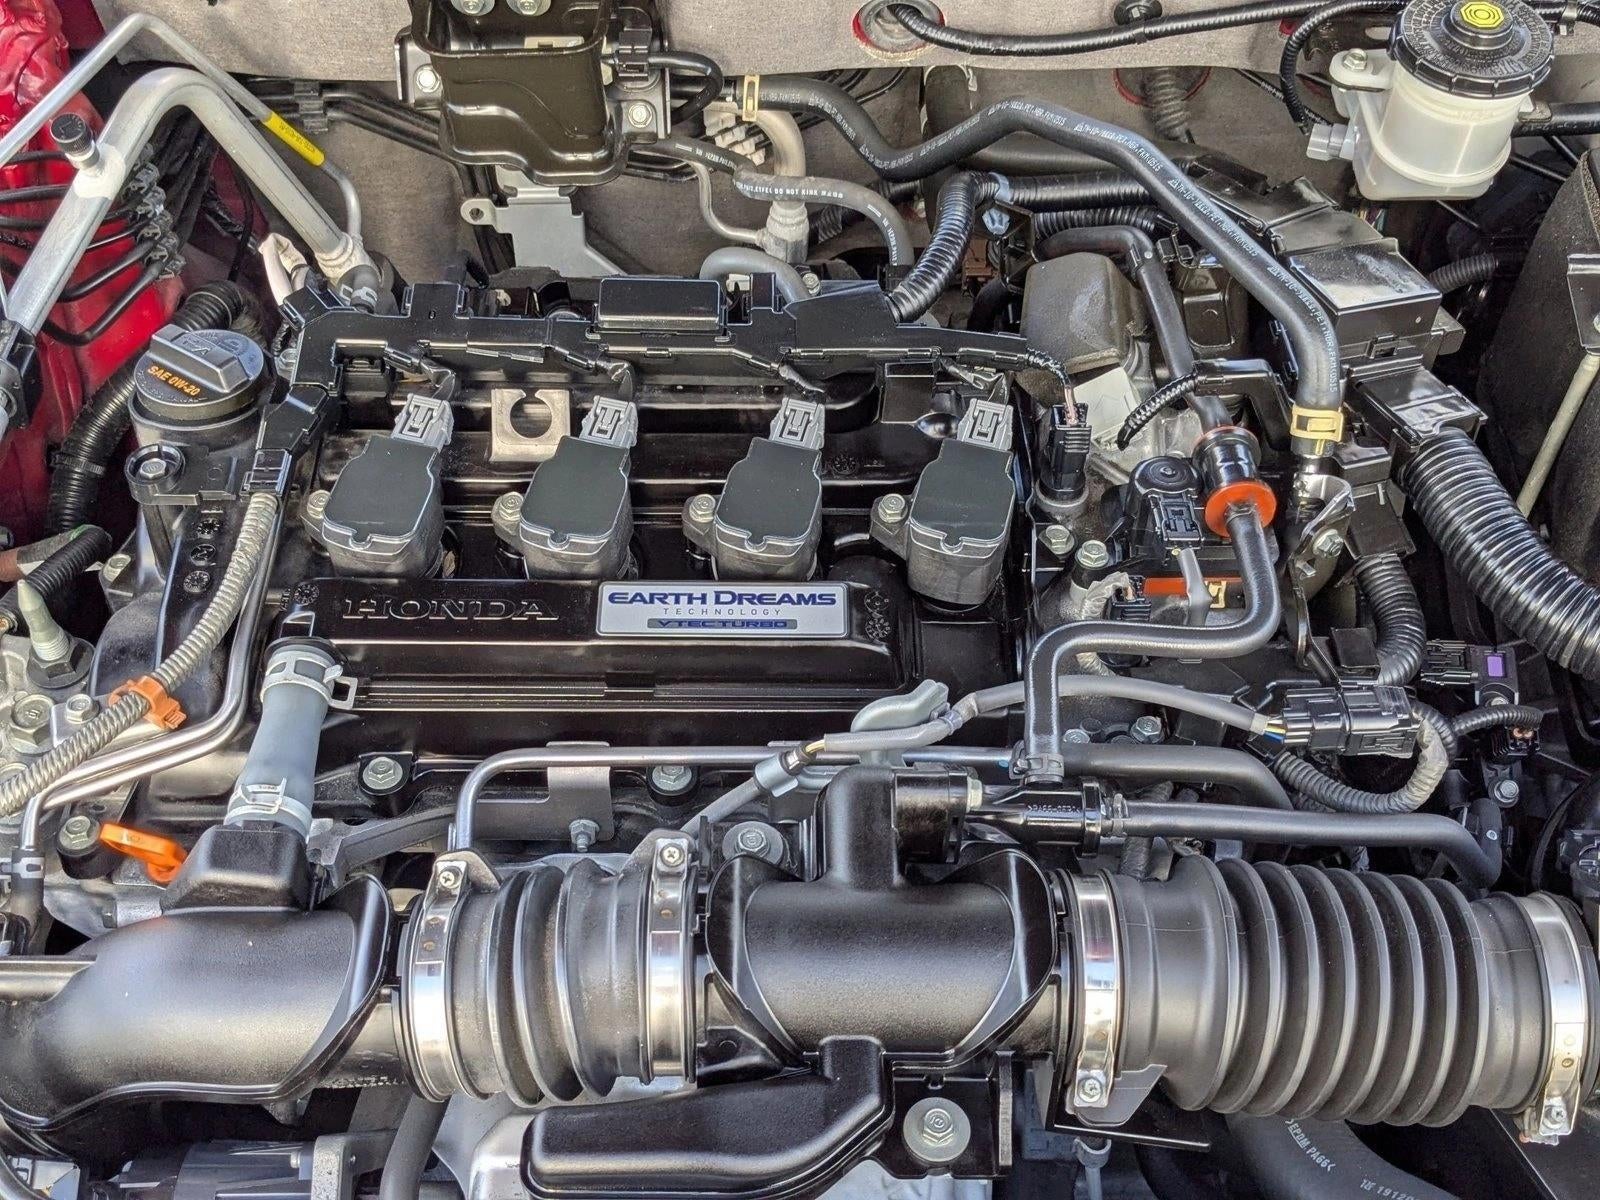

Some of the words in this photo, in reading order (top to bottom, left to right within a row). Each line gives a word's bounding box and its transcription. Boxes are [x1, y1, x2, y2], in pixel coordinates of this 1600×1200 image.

[147, 365, 173, 381] SAE
[169, 376, 201, 396] 0W-20
[608, 591, 707, 605] EARTH
[713, 590, 837, 606] DREAMS
[343, 599, 560, 621] HONDA
[663, 607, 782, 617] TECHNOLOGY
